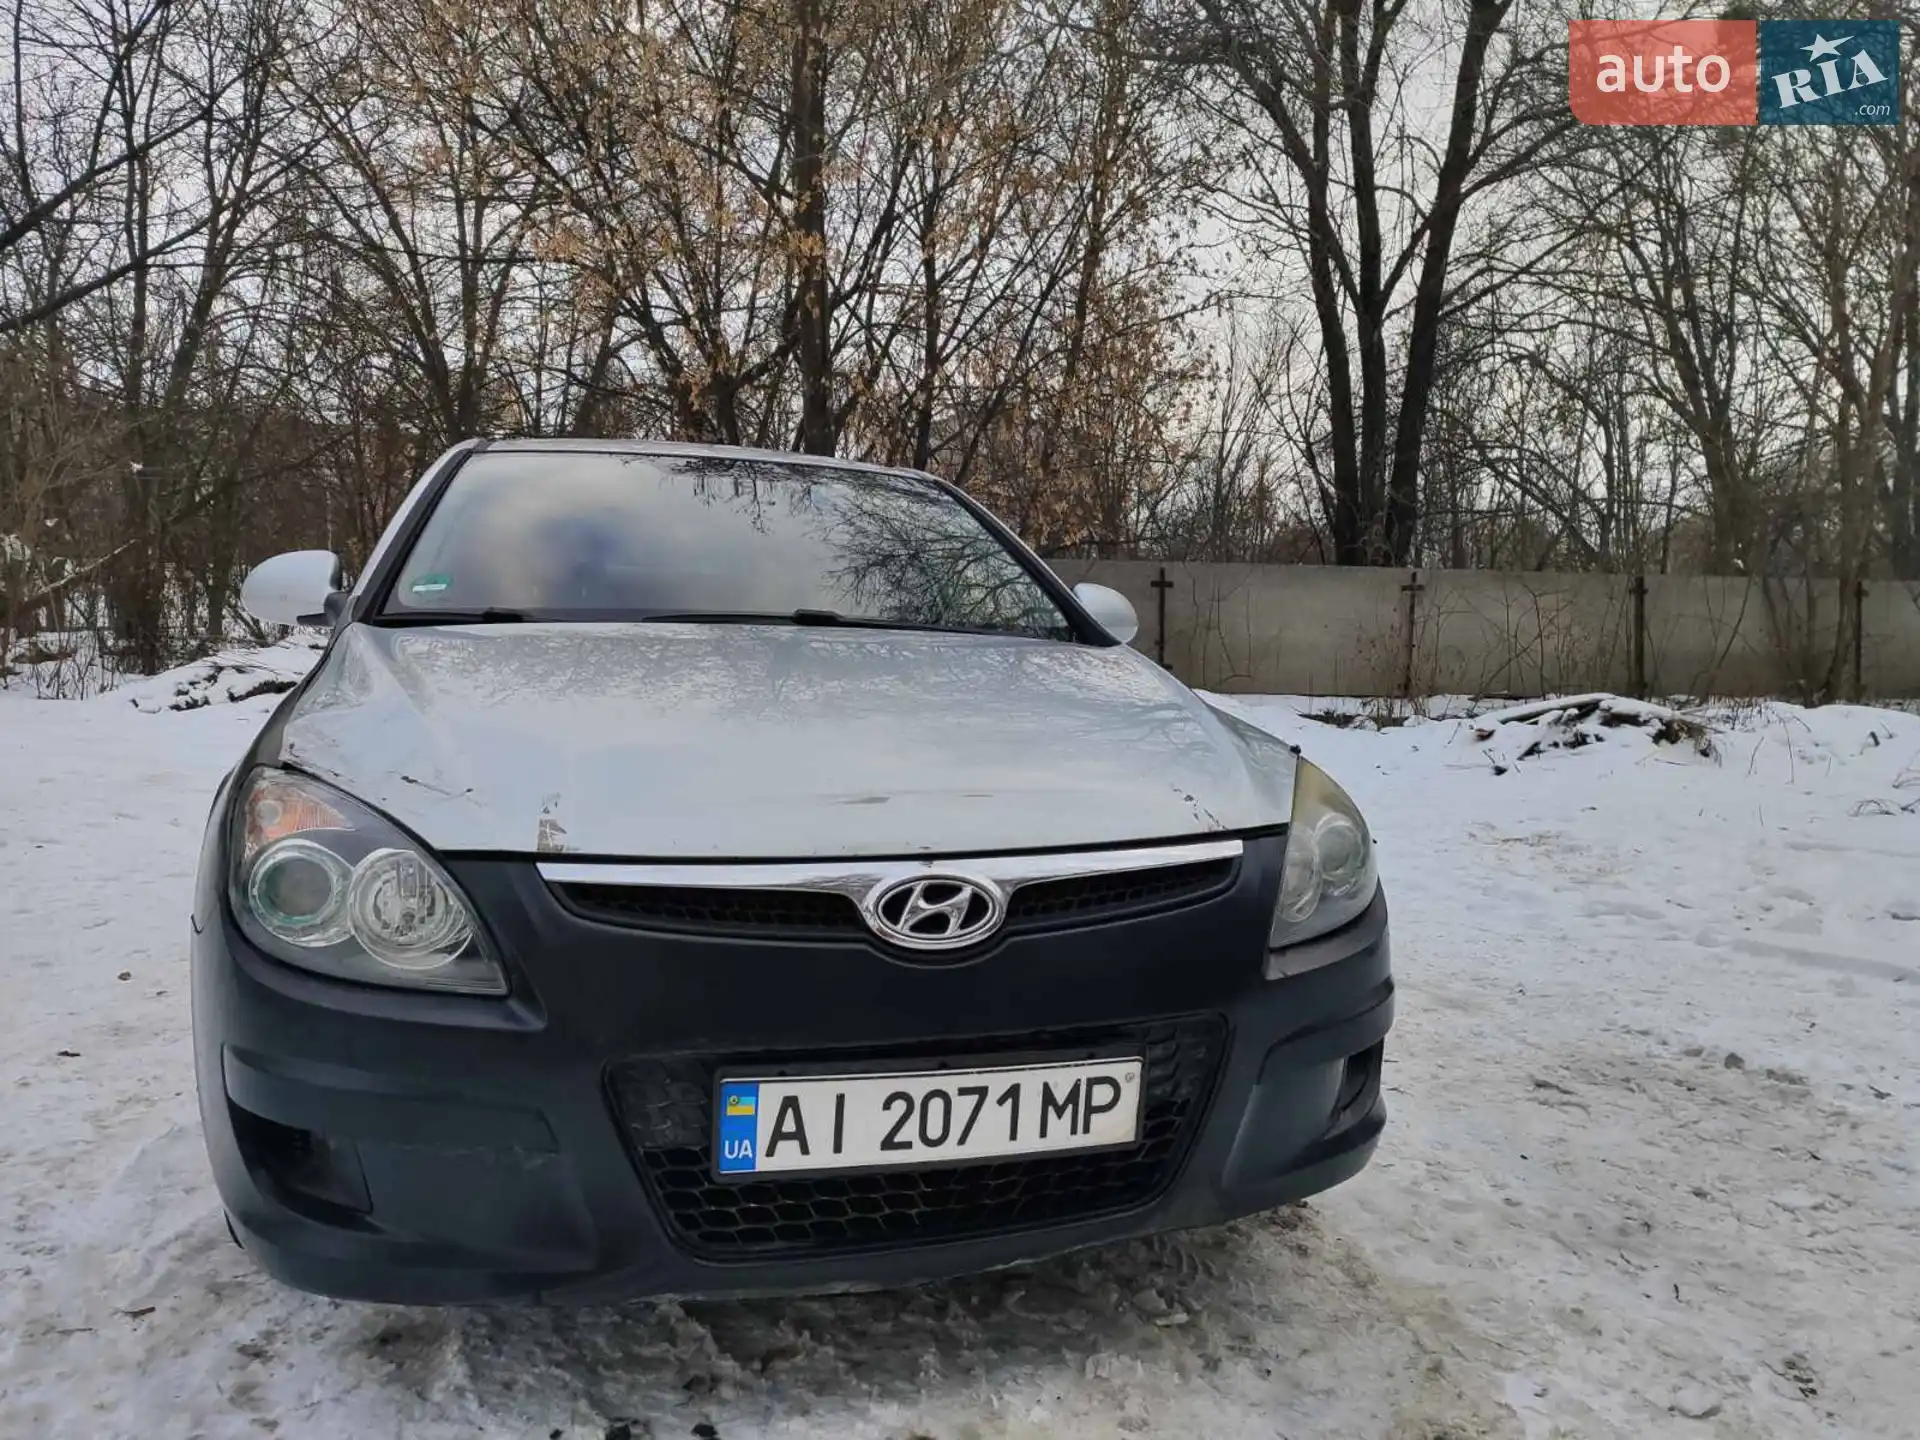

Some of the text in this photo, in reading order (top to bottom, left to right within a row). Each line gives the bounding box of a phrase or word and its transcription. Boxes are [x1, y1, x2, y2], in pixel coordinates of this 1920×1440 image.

[765, 1075, 1122, 1158] AI 2071 MP
[724, 1139, 753, 1160] UA
